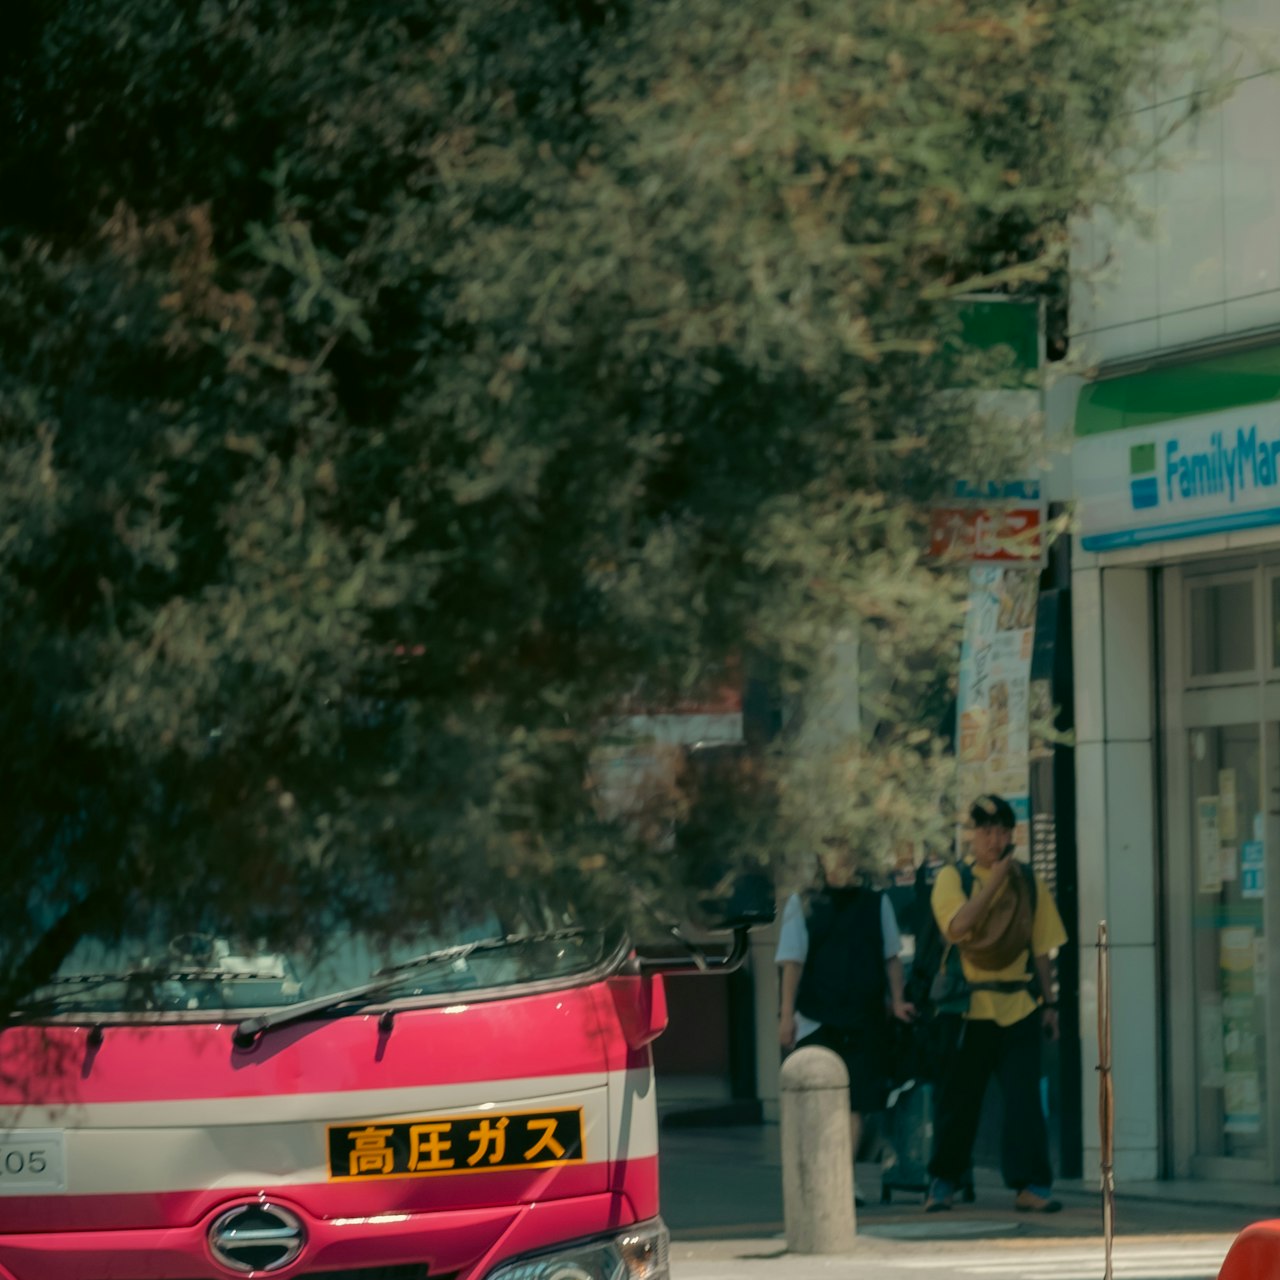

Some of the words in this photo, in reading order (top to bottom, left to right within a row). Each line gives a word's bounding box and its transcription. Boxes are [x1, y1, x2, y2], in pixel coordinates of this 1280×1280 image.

[0, 1149, 47, 1176] 05
[347, 1116, 566, 1176] 高圧ガス
